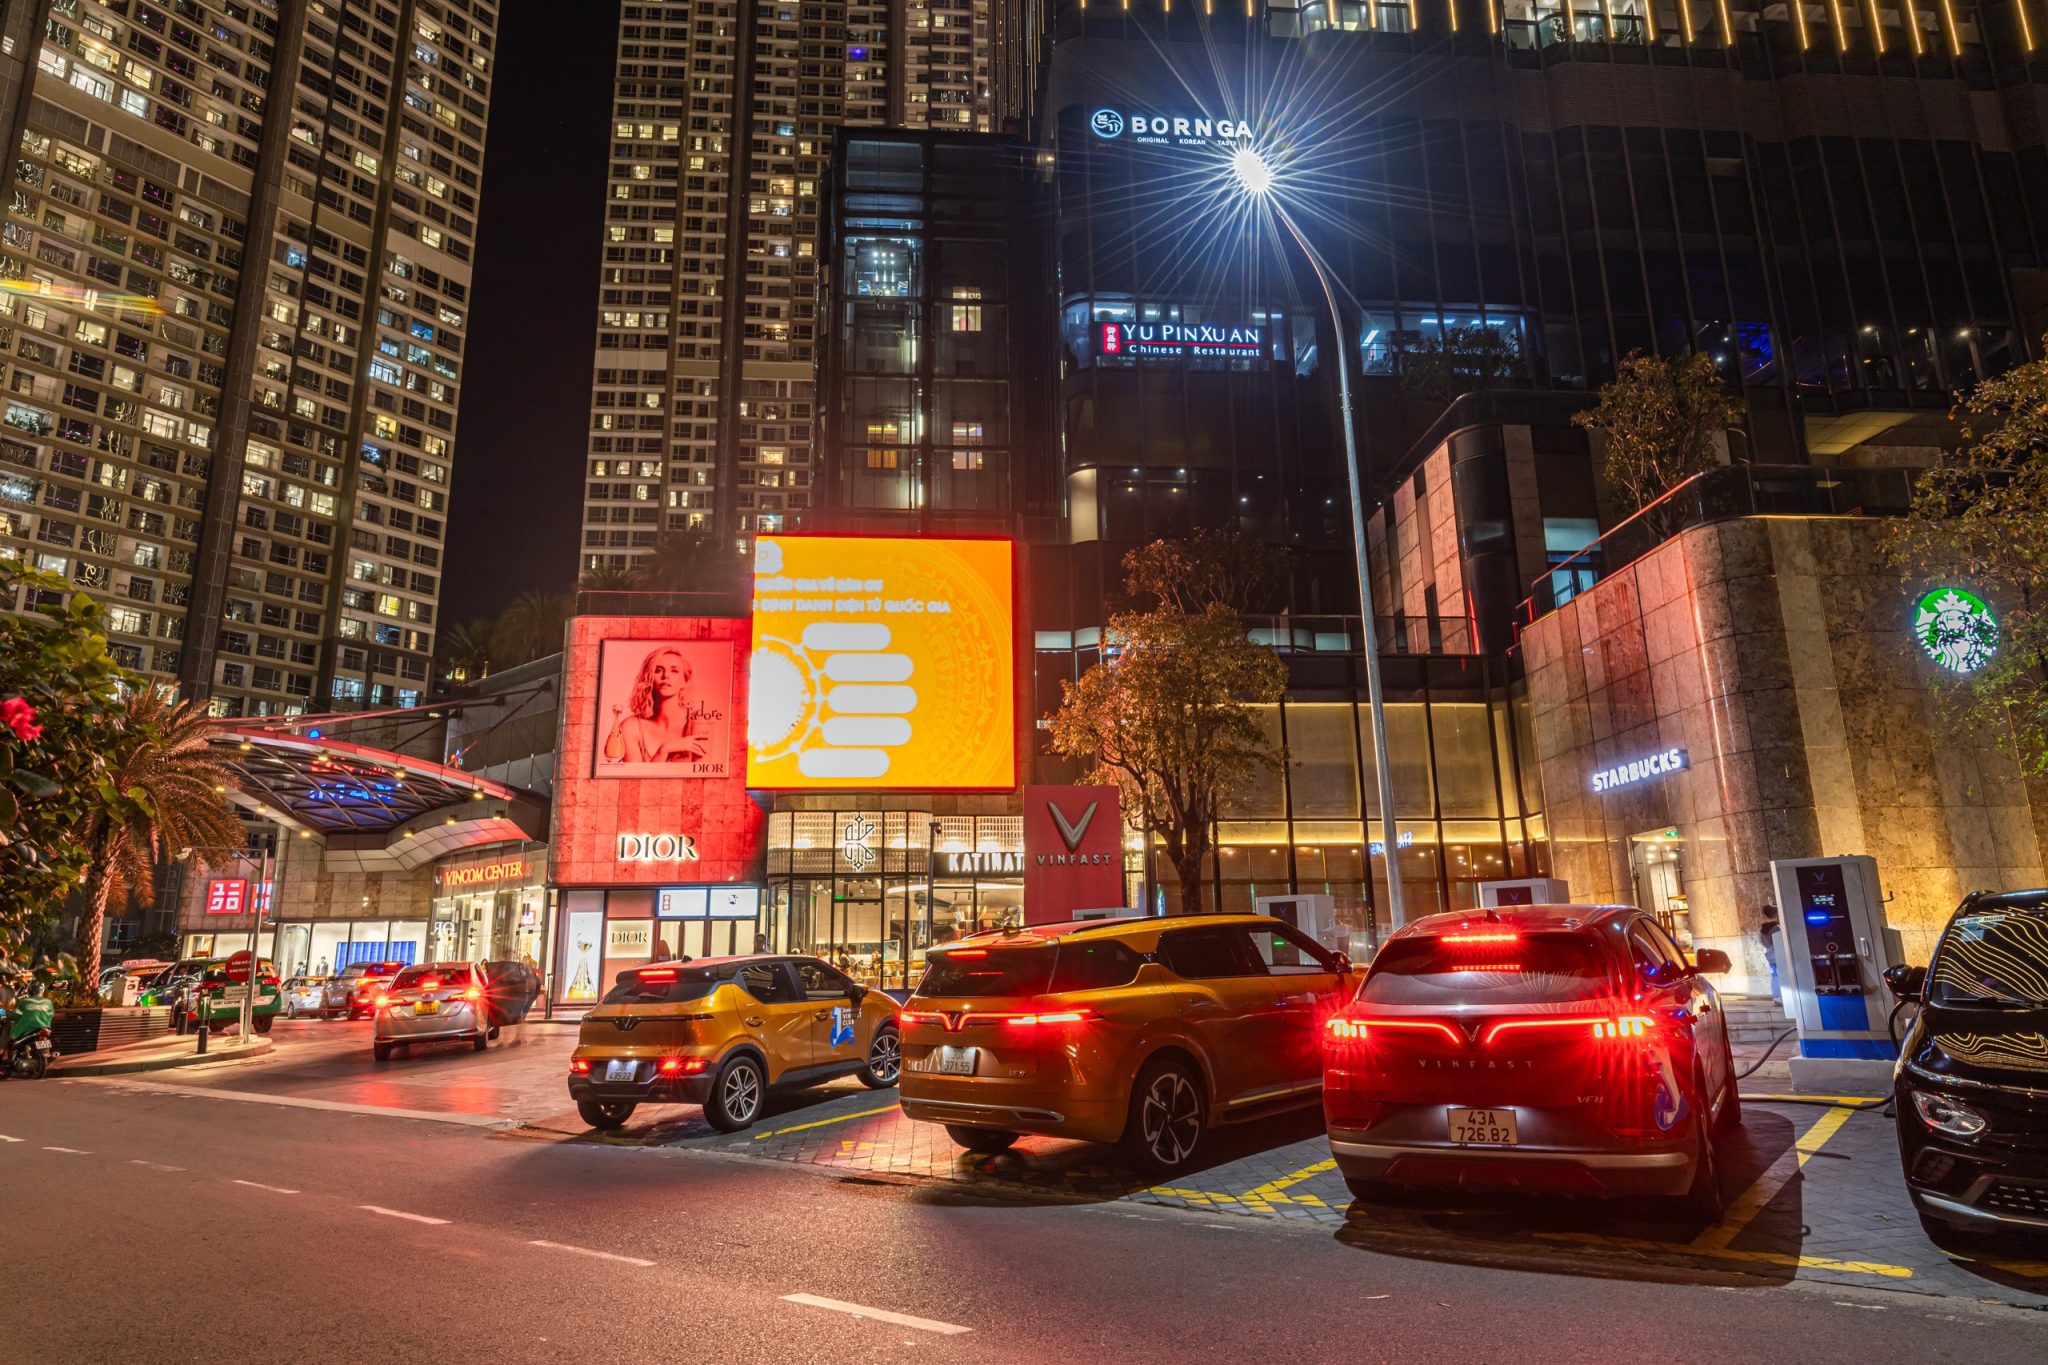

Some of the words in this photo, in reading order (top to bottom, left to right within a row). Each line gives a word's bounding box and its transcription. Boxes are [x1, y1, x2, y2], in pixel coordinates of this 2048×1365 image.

[1131, 116, 1253, 138] BORNGA
[1137, 136, 1169, 144] ORIGINAL
[1123, 324, 1153, 340] YU
[1129, 344, 1182, 354] Chinese
[1193, 346, 1260, 357] Restaurant
[884, 598, 924, 612] QUỐC
[926, 601, 951, 612] GIA
[692, 763, 724, 773] DIOR
[1592, 748, 1681, 792] STARBUCKS
[620, 835, 697, 859] DIOR
[949, 852, 1024, 872] KATINAT
[1037, 854, 1111, 865] VINFAST
[445, 867, 484, 885] VINCOM
[485, 861, 523, 879] CENTER
[611, 932, 647, 943] DIOR
[1418, 1059, 1533, 1069] VINFAST
[1467, 1110, 1496, 1126] 43A
[1456, 1126, 1511, 1142] 726.82
